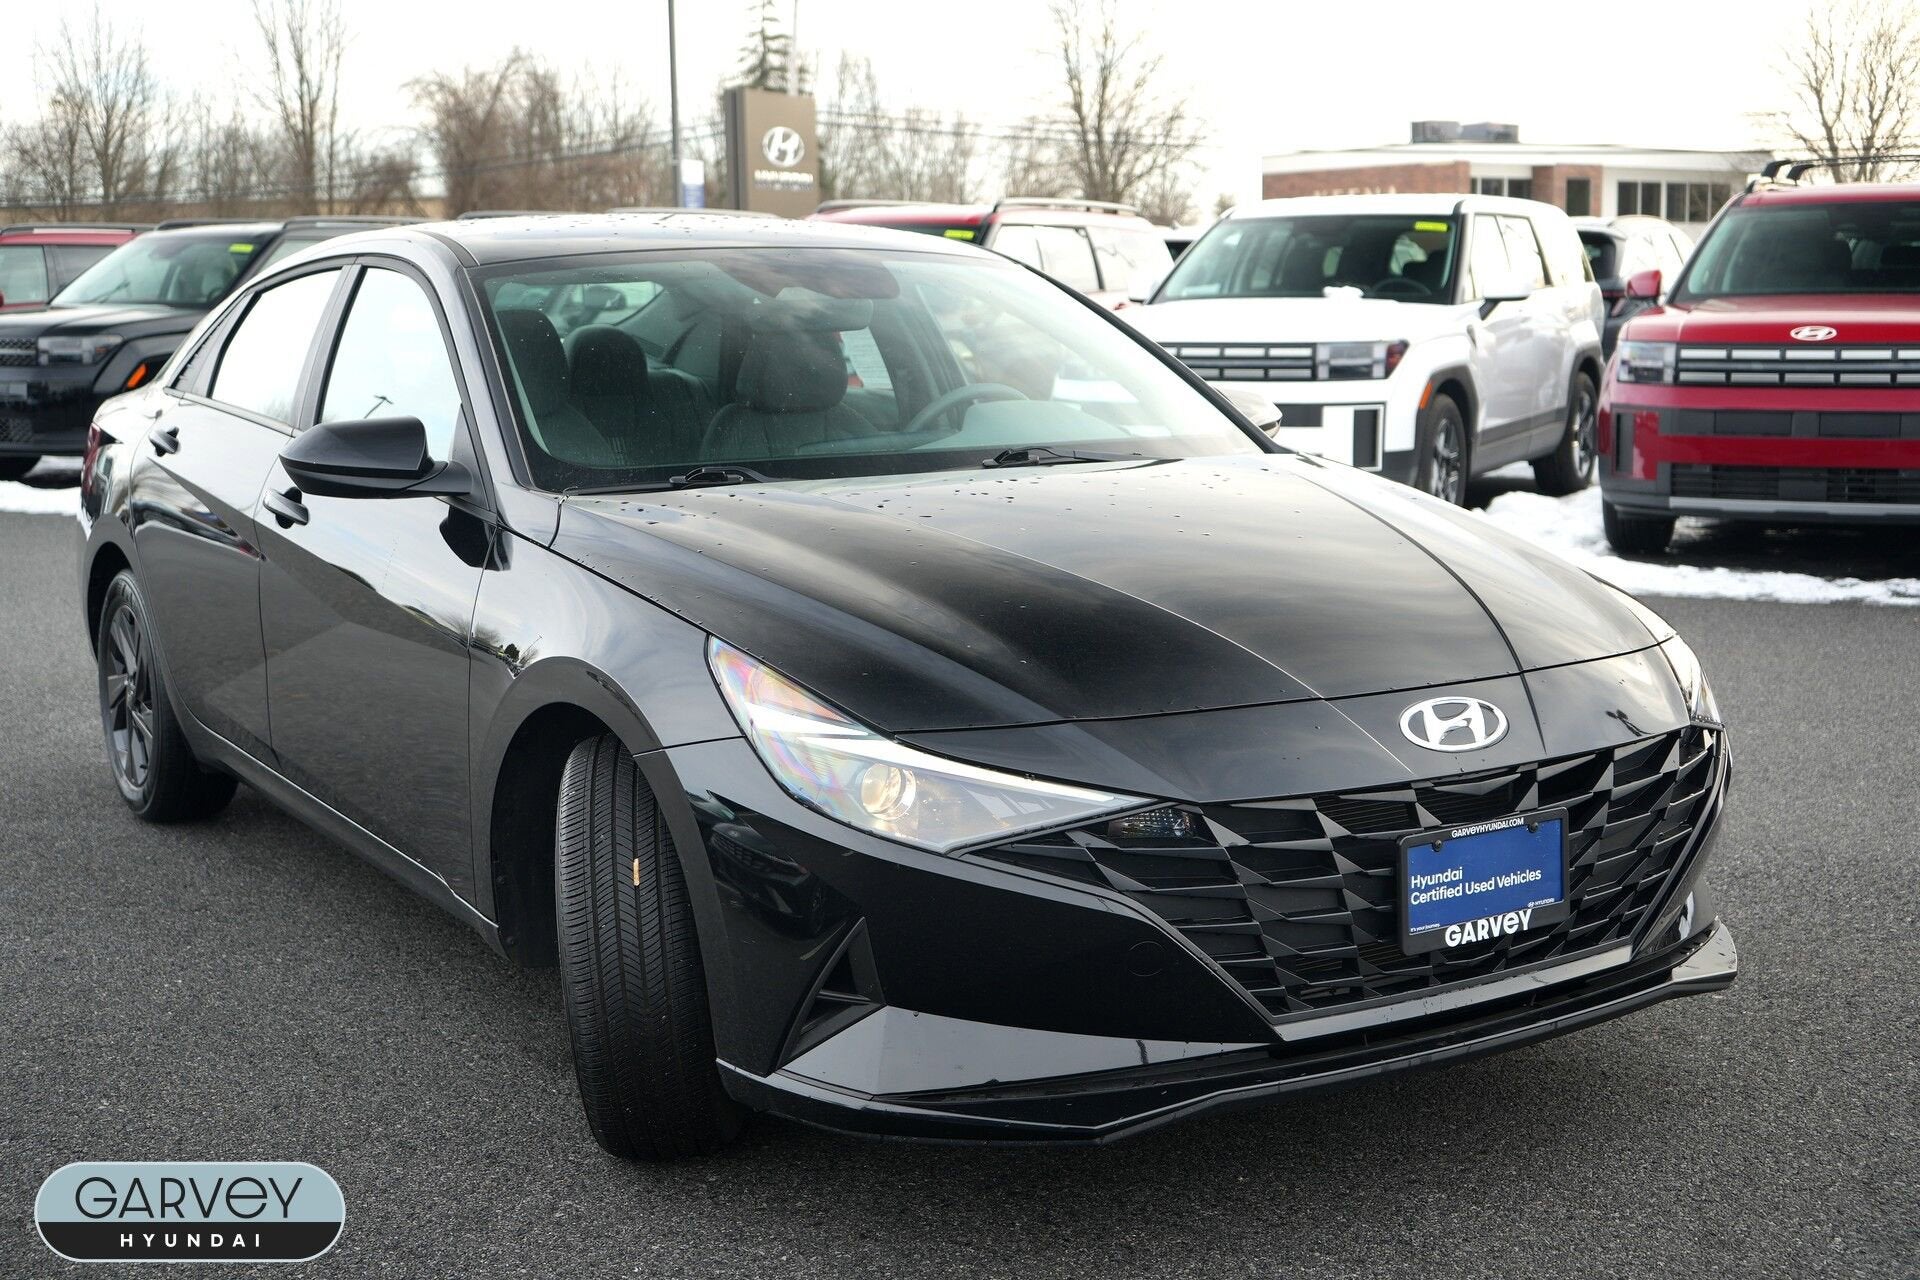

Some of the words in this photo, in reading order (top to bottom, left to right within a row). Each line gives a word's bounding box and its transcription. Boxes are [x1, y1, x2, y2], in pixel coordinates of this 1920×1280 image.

[1410, 883, 1463, 905] Certified
[1465, 878, 1495, 895] Used
[1496, 869, 1541, 888] Vehicles
[1411, 867, 1463, 889] Hyundai
